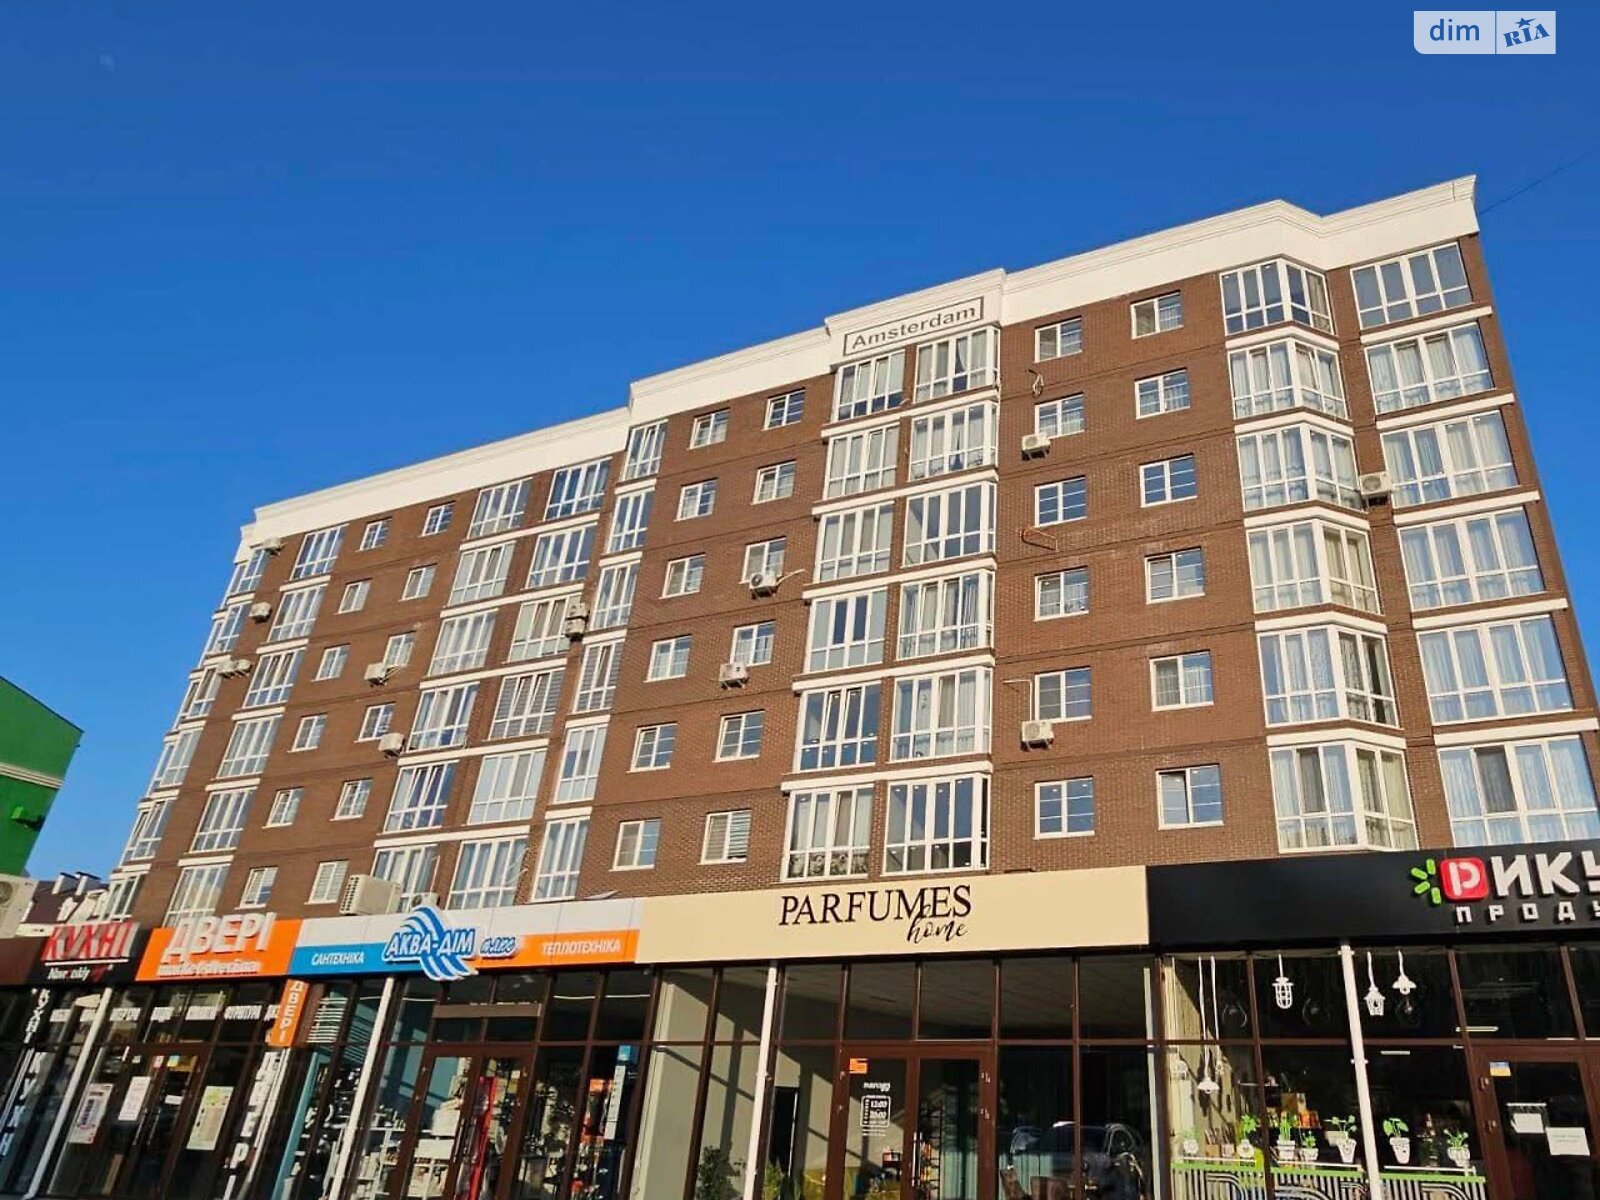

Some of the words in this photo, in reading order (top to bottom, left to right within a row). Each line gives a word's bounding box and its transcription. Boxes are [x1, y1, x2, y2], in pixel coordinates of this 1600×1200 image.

[852, 306, 976, 349] Amsterdam
[778, 884, 972, 926] PARFUMES
[906, 902, 968, 944] home
[41, 920, 139, 961] КУХНІ
[160, 911, 277, 965] ДВЕРІ
[311, 951, 365, 966] САНТЕХНІКА
[386, 928, 476, 957] АКВА-ДІМ
[543, 938, 621, 956] ТЕПЛОТЕХНІКА
[280, 980, 303, 1043] ДВЕРІ
